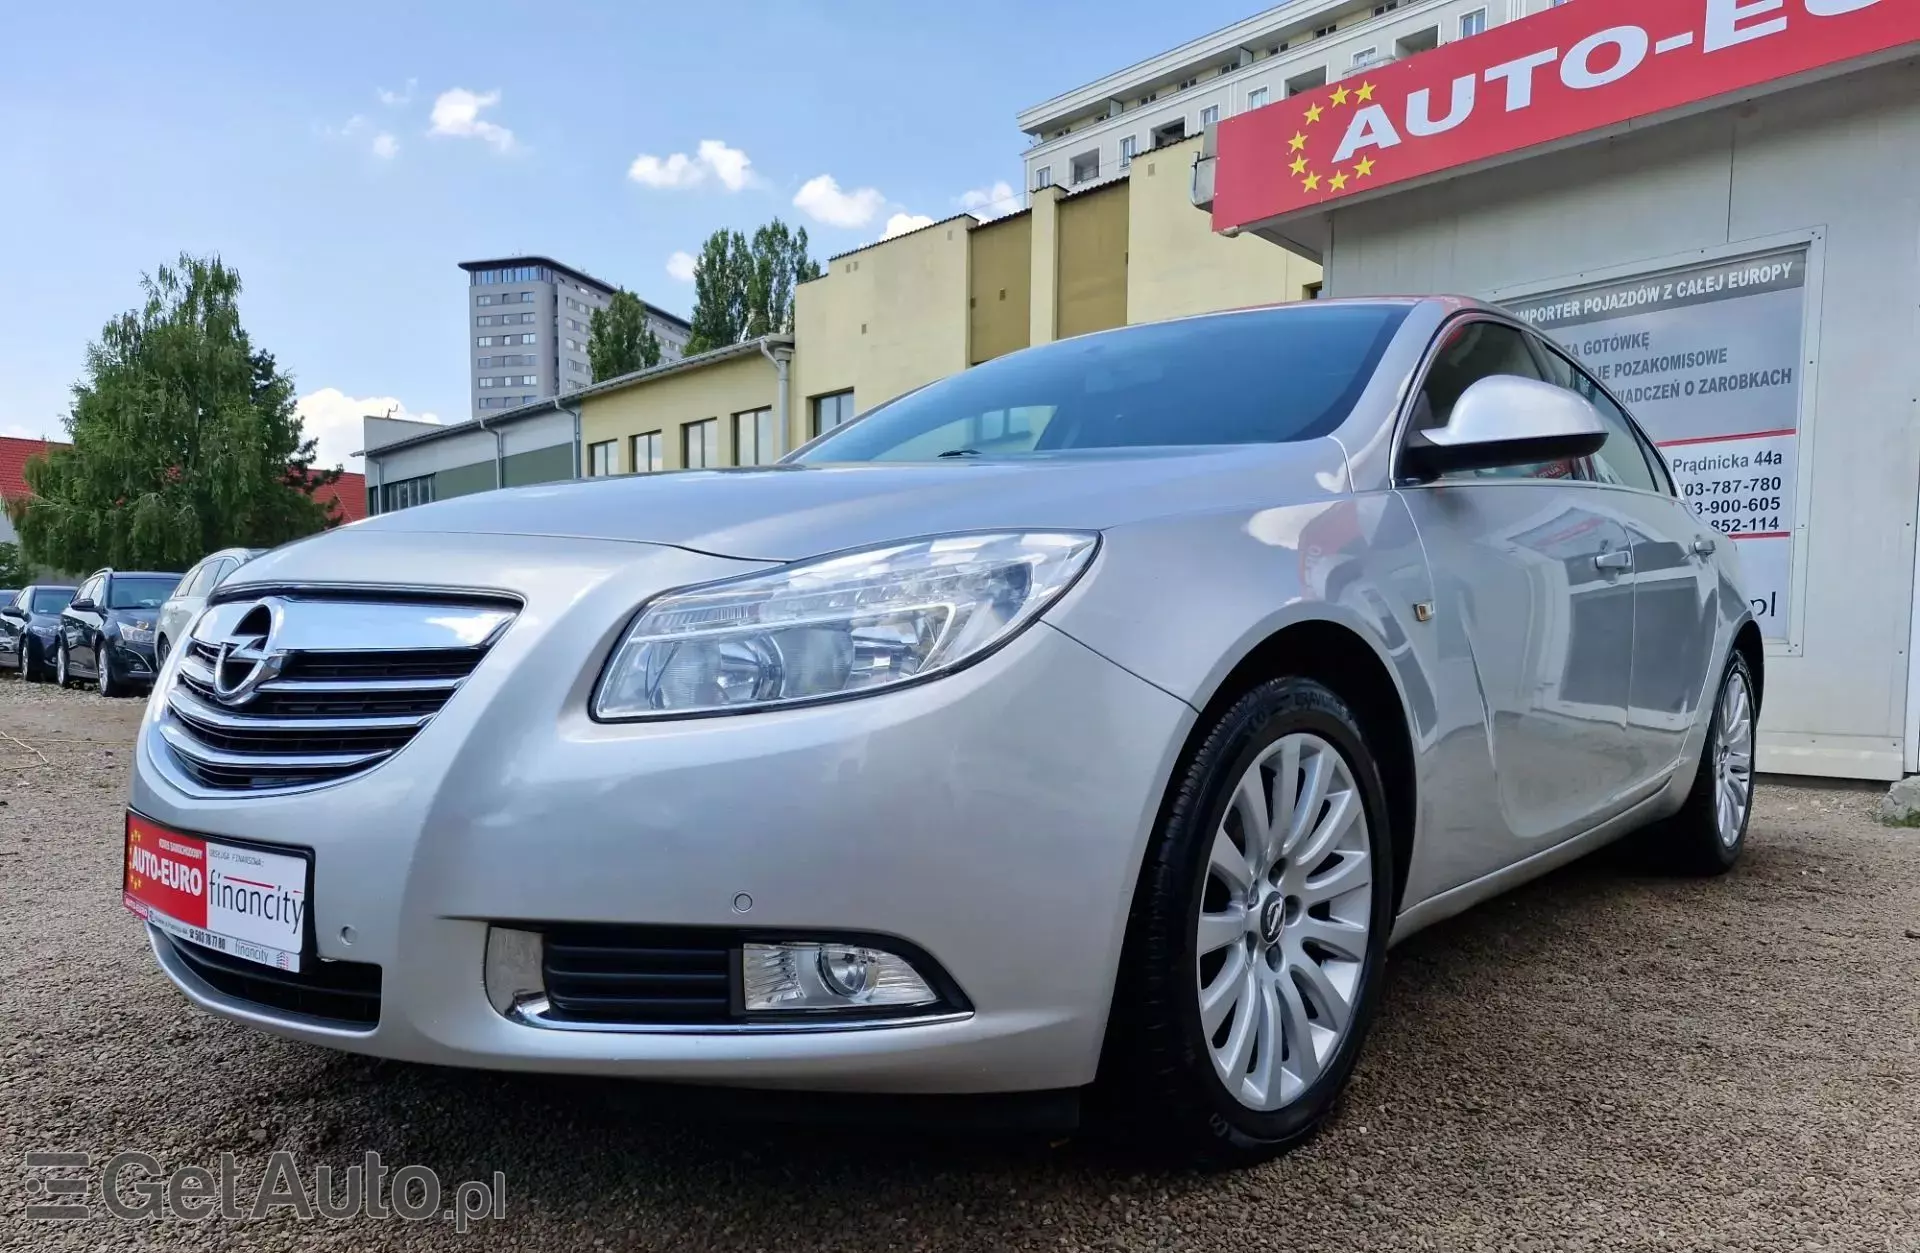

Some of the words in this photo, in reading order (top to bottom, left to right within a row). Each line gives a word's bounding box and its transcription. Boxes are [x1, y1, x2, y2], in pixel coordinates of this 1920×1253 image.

[1331, 0, 1881, 163] AUTO-E
[1583, 283, 1660, 315] POJAZDÓW
[1663, 284, 1674, 300] Z
[1676, 275, 1723, 298] CAŁEJ
[1728, 261, 1793, 289] EUROPY
[1583, 331, 1651, 356] GOTÓWKĘ
[1614, 347, 1728, 378] POZAKOMISOWE
[1684, 380, 1695, 396] O
[1698, 368, 1793, 395] ZAROBKACH
[1672, 453, 1749, 476] Prądnicka
[1753, 450, 1783, 466] 44a
[1682, 476, 1782, 497] 03-787-780
[132, 845, 203, 897] AUTO-EURO
[209, 869, 305, 934] financity
